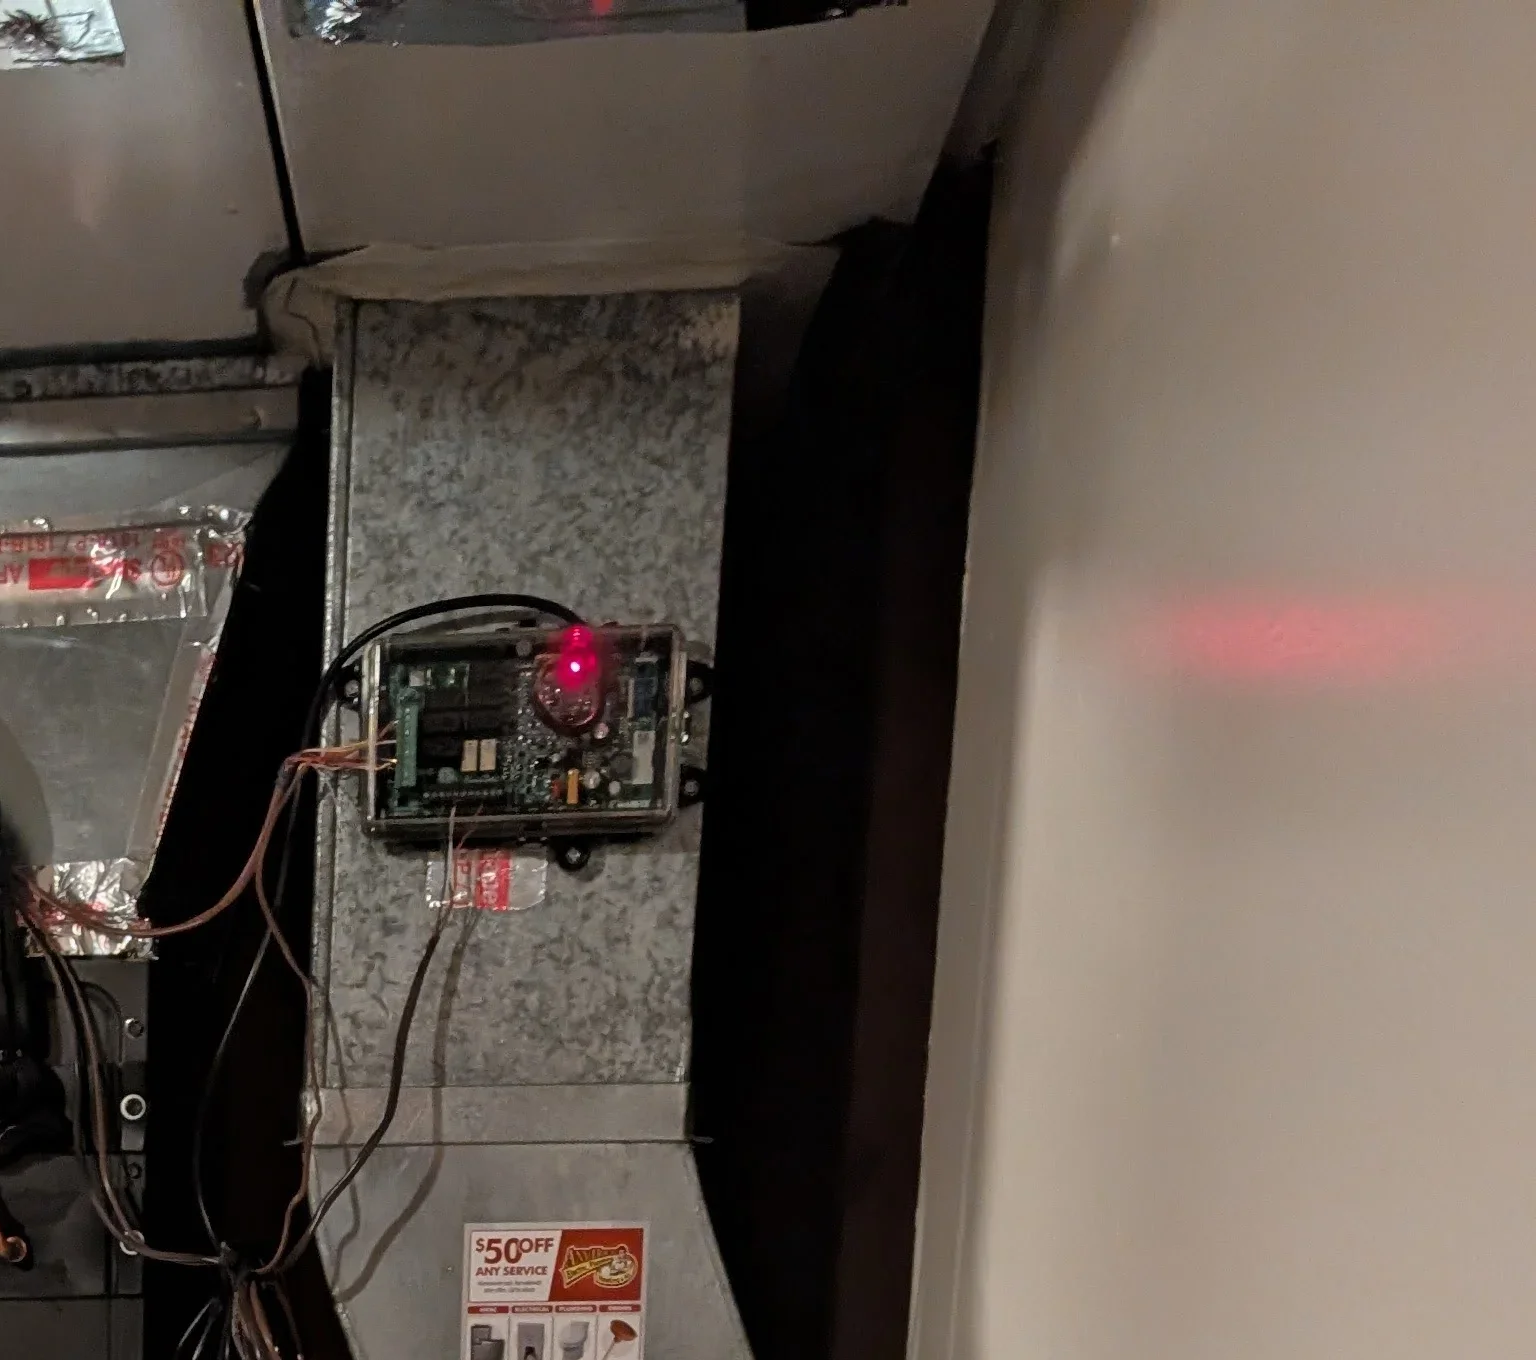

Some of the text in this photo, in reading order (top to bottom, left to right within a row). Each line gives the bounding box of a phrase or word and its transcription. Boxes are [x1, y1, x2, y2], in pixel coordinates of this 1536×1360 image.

[475, 1237, 554, 1265] $50 OFF
[475, 1265, 548, 1277] ANY SERVICE
